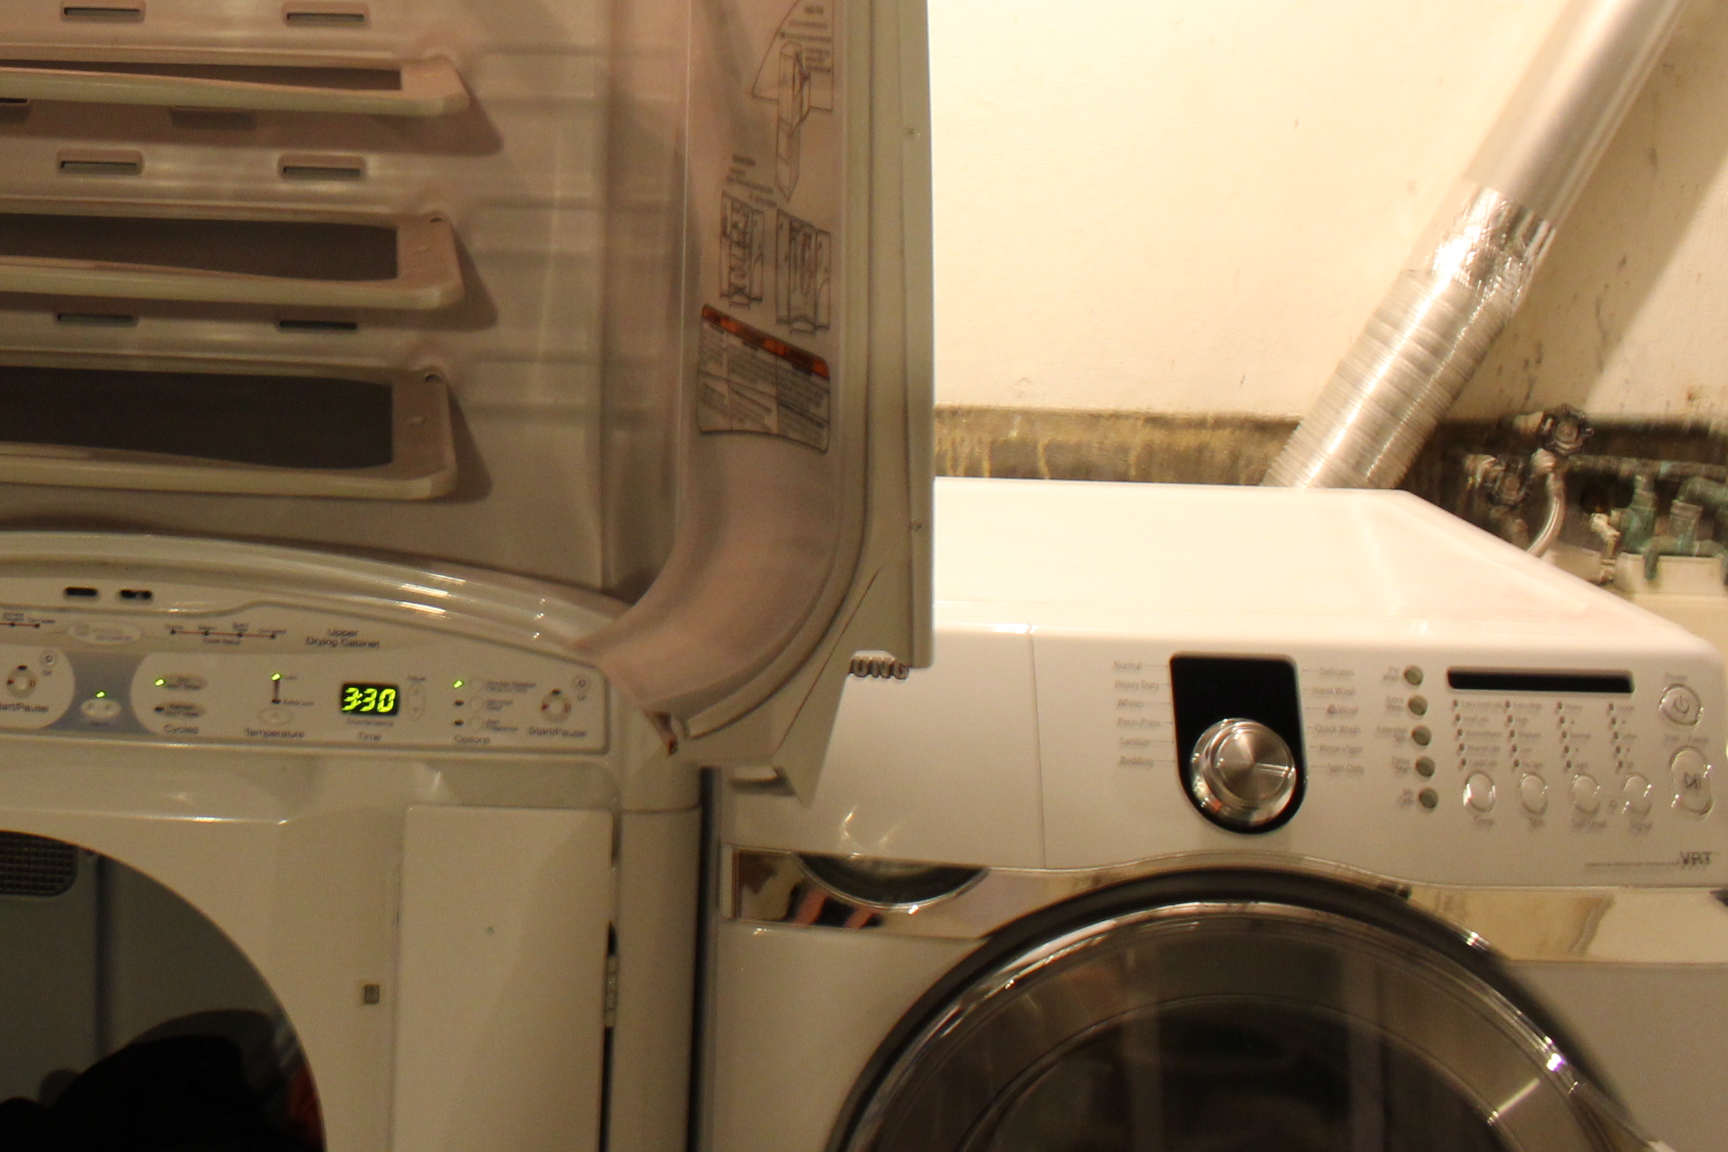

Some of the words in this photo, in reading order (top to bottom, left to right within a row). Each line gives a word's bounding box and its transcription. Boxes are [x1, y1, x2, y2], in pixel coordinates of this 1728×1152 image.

[328, 628, 359, 638] Upper
[306, 636, 339, 648] Drying
[341, 638, 381, 648] Cabinet
[341, 687, 396, 713] 3:30
[164, 724, 200, 735] Cycles
[245, 727, 305, 739] Temperature
[528, 727, 588, 738] Start/Pause
[358, 732, 382, 741] Time
[454, 734, 492, 744] Options
[1680, 851, 1712, 867] VRT
